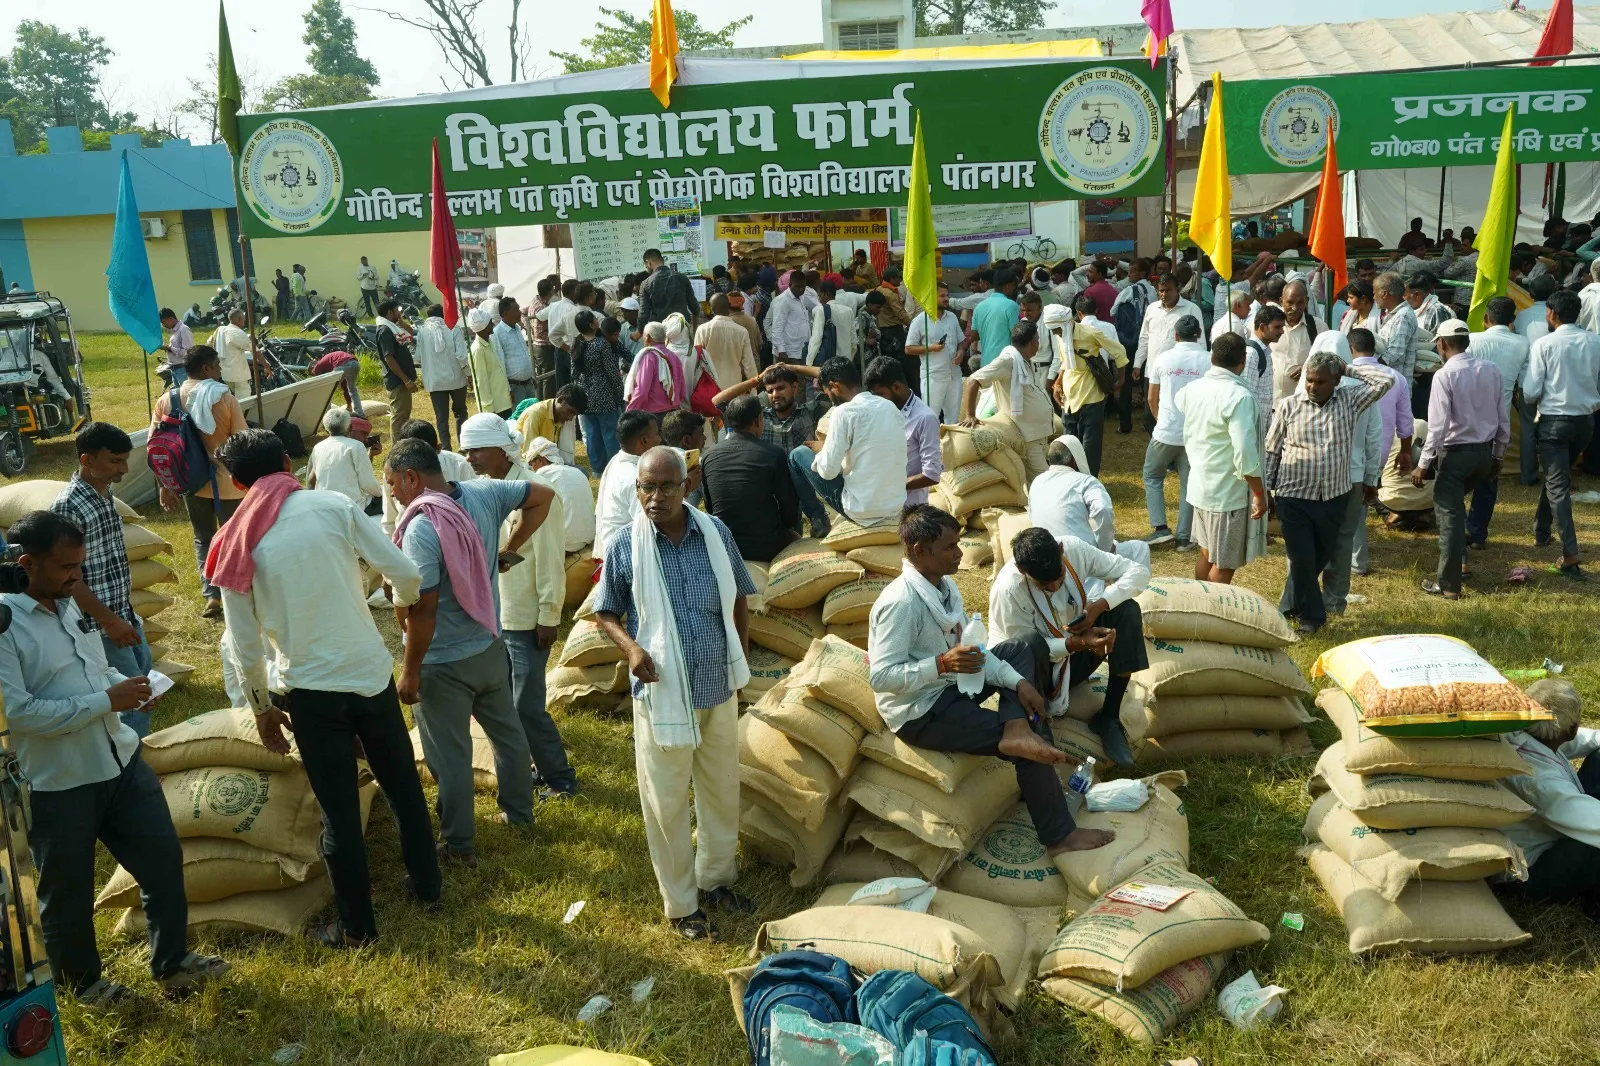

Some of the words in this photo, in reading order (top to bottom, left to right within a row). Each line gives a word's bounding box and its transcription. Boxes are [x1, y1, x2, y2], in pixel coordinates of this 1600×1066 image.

[1076, 71, 1093, 85] कृषि
[1095, 69, 1108, 79] एवं
[1059, 90, 1085, 124] UNIVERSITY
[1391, 89, 1593, 124] प्रजनक
[445, 104, 777, 172] विश्वविद्यालय
[792, 83, 917, 147] फार्म
[1448, 131, 1485, 154] पंत
[1549, 127, 1589, 152] एवं
[1080, 167, 1120, 177] PANTNAGAR
[345, 188, 423, 221] गोविन्द
[429, 187, 502, 217] ल्लभ
[508, 178, 544, 212] पंत
[549, 175, 599, 220] कृषि
[605, 170, 641, 207] एवं
[647, 167, 755, 206] प्रौद्योगिक
[941, 153, 1037, 191] पंतनगर
[720, 226, 741, 235] उन्नत
[743, 224, 760, 235] खेती
[812, 223, 823, 235] की
[232, 815, 254, 834] प्रतीक
[972, 856, 989, 870] का
[988, 863, 1021, 879] उन्नति
[1023, 869, 1047, 882] बीज
